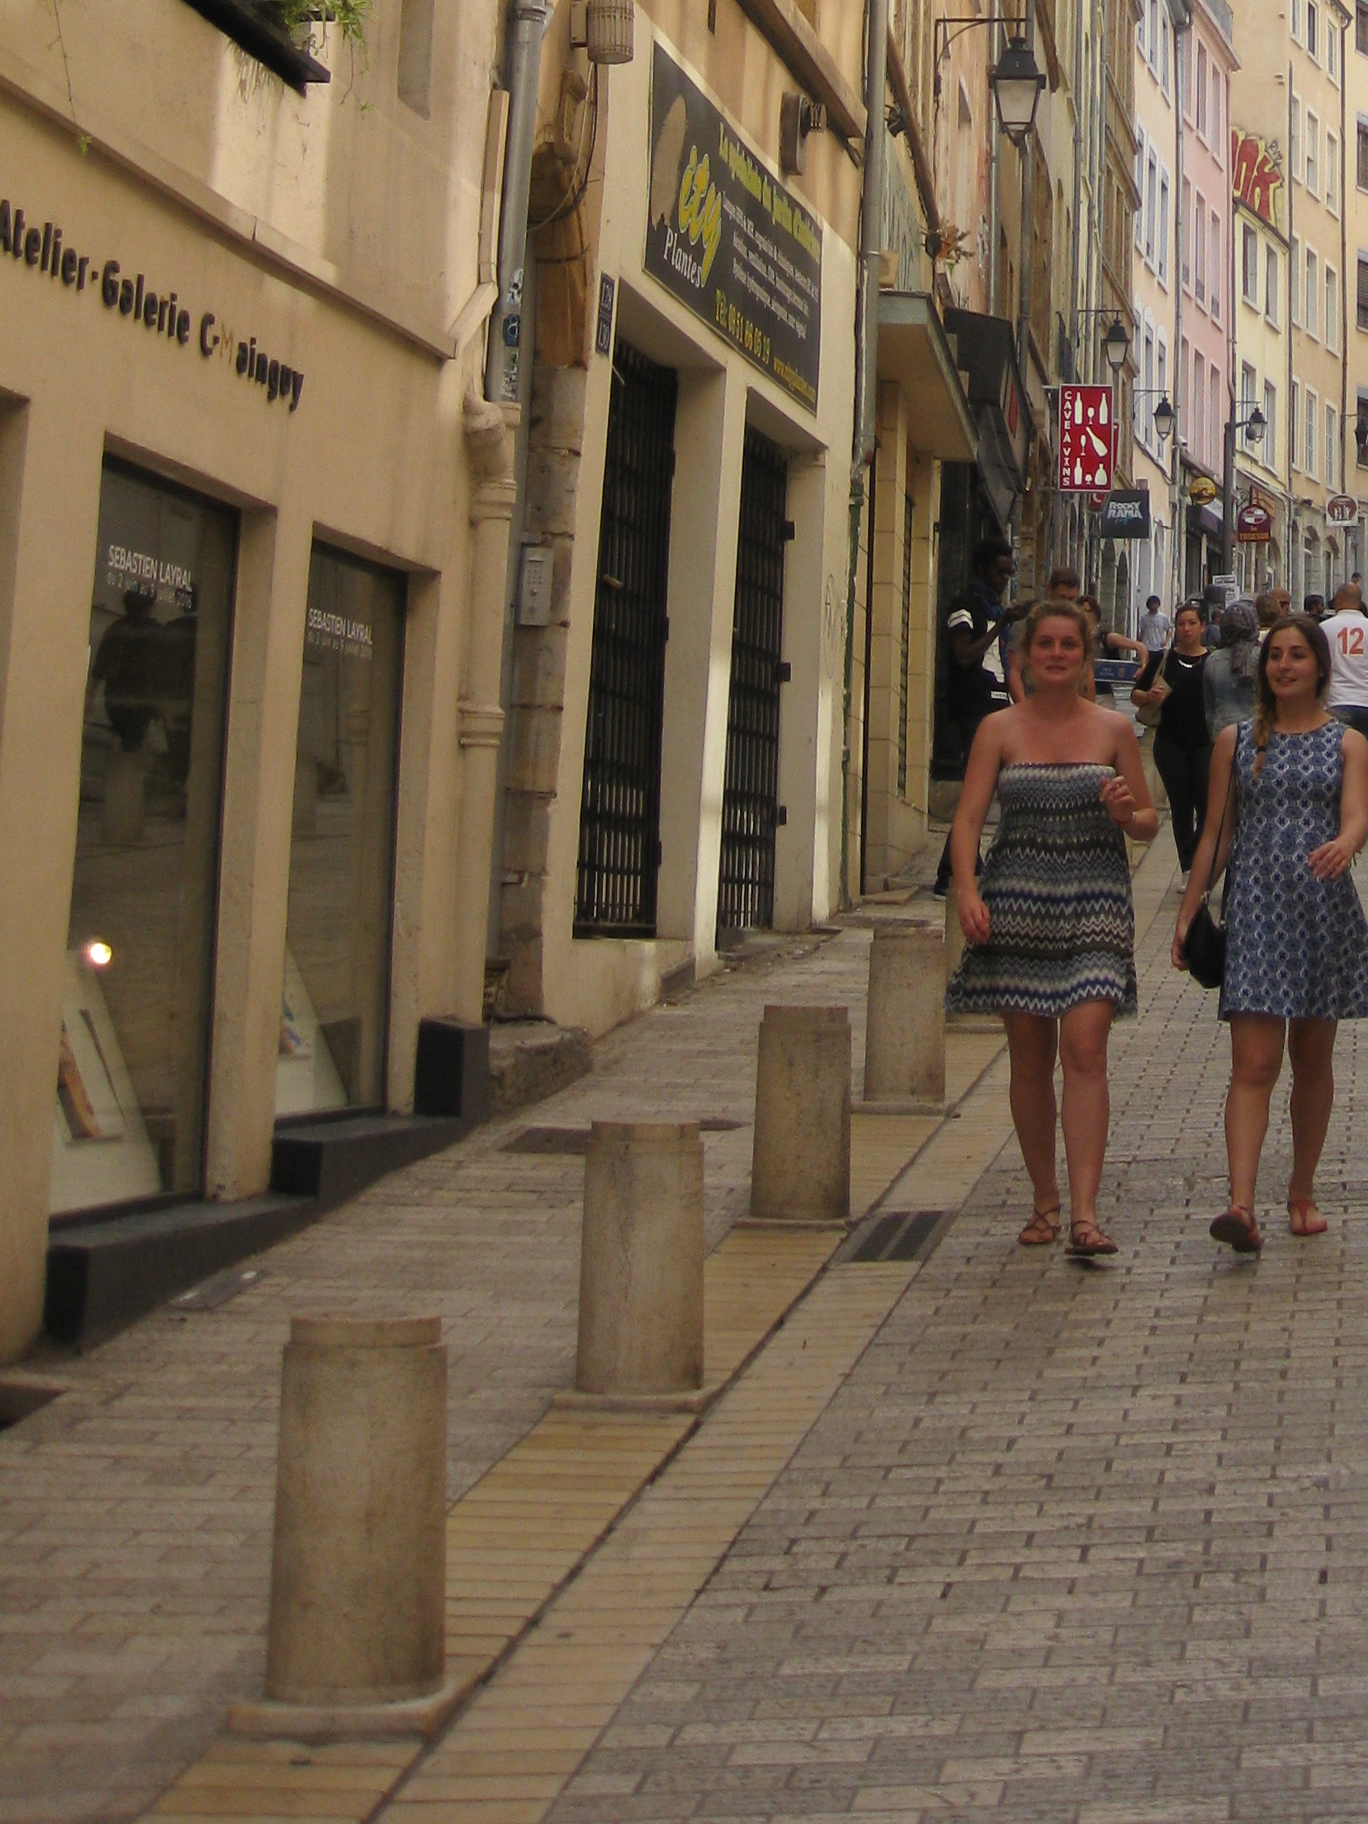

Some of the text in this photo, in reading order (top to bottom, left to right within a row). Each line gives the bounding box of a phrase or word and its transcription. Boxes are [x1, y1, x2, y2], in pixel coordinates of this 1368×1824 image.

[663, 227, 702, 289] Plantes
[1063, 391, 1072, 429] CAVE
[1062, 447, 1071, 486] VINS
[108, 545, 192, 592] SEBASTIEN LAYRAL
[1337, 627, 1365, 654] 12
